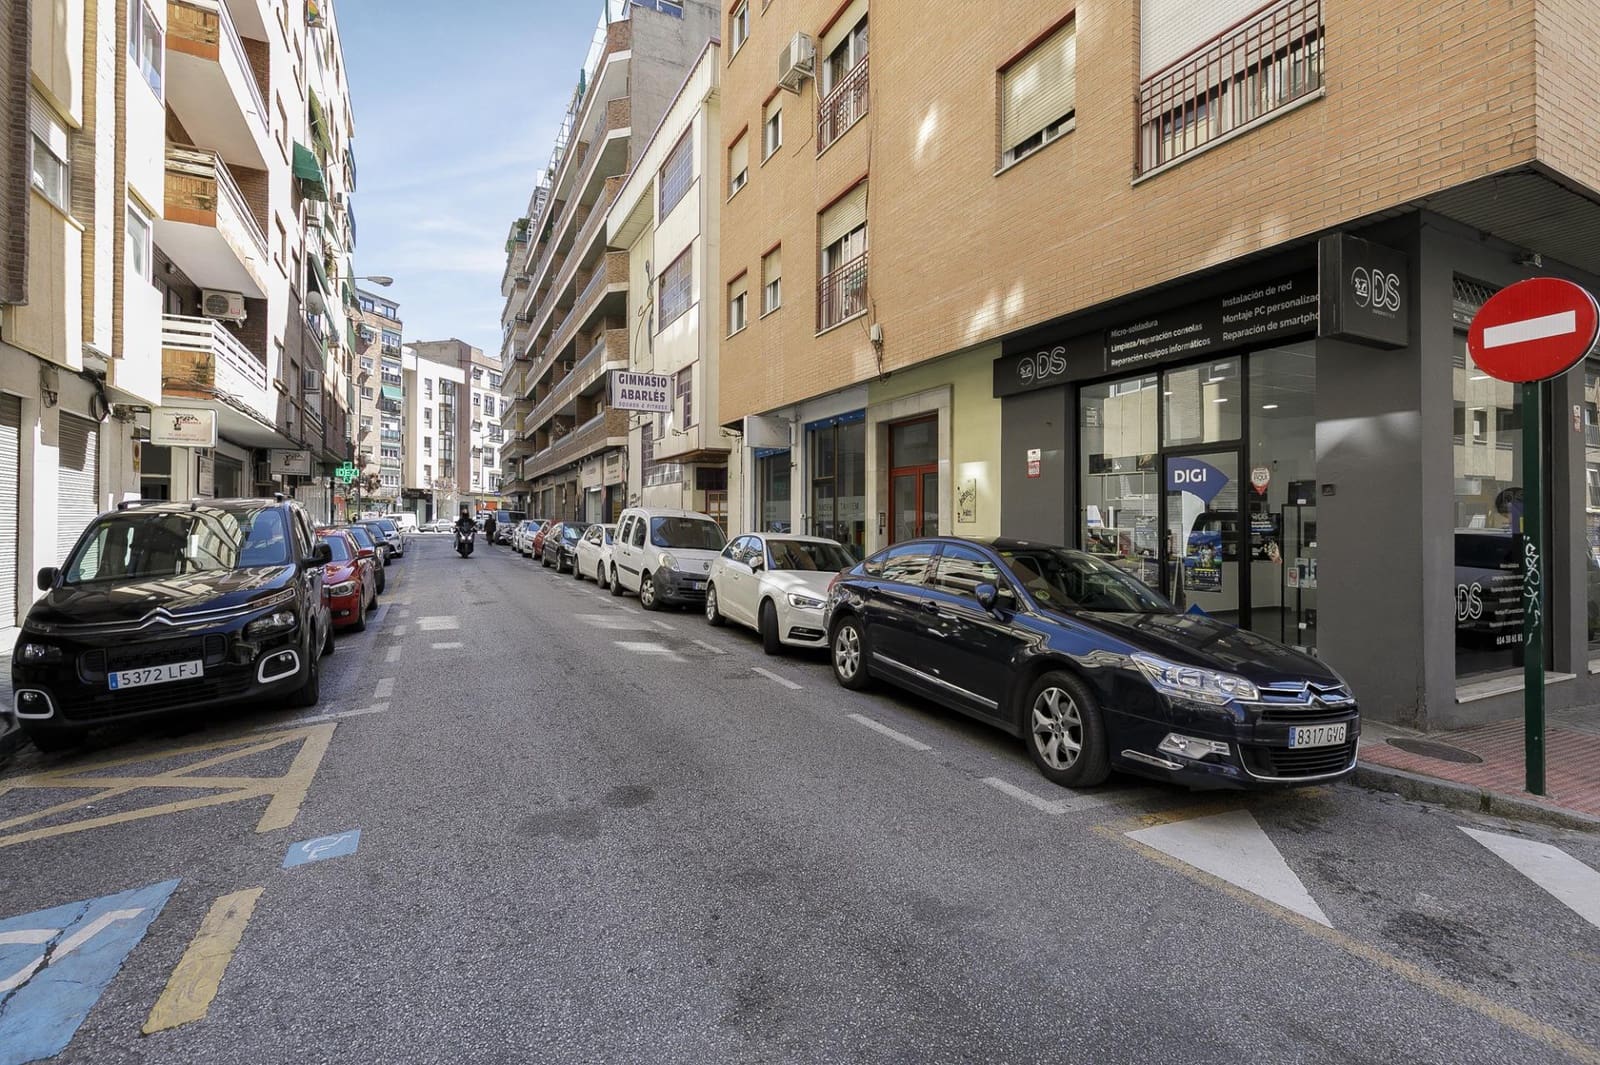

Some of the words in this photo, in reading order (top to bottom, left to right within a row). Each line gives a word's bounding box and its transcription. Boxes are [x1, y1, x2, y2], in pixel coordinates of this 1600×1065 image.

[1222, 289, 1264, 308] Instalación
[1265, 285, 1276, 296] de
[1277, 280, 1293, 293] red
[1372, 269, 1401, 312] DS
[1222, 309, 1254, 325] Montaje
[1254, 306, 1266, 317] PC
[1172, 323, 1203, 337] consolas
[1222, 323, 1266, 341] Reparación
[1266, 320, 1279, 331] de
[1037, 346, 1067, 379] DS
[1111, 353, 1144, 368] Reparación
[1143, 347, 1169, 360] equipos
[618, 373, 667, 388] GIMNASIO
[620, 388, 666, 402] ABARLÉS
[1174, 468, 1207, 484] DIGI
[1458, 582, 1483, 621] DS
[121, 667, 163, 686] 5372
[168, 662, 199, 679] LFJ
[1297, 727, 1325, 745] 8317
[1326, 726, 1345, 742] GVG
